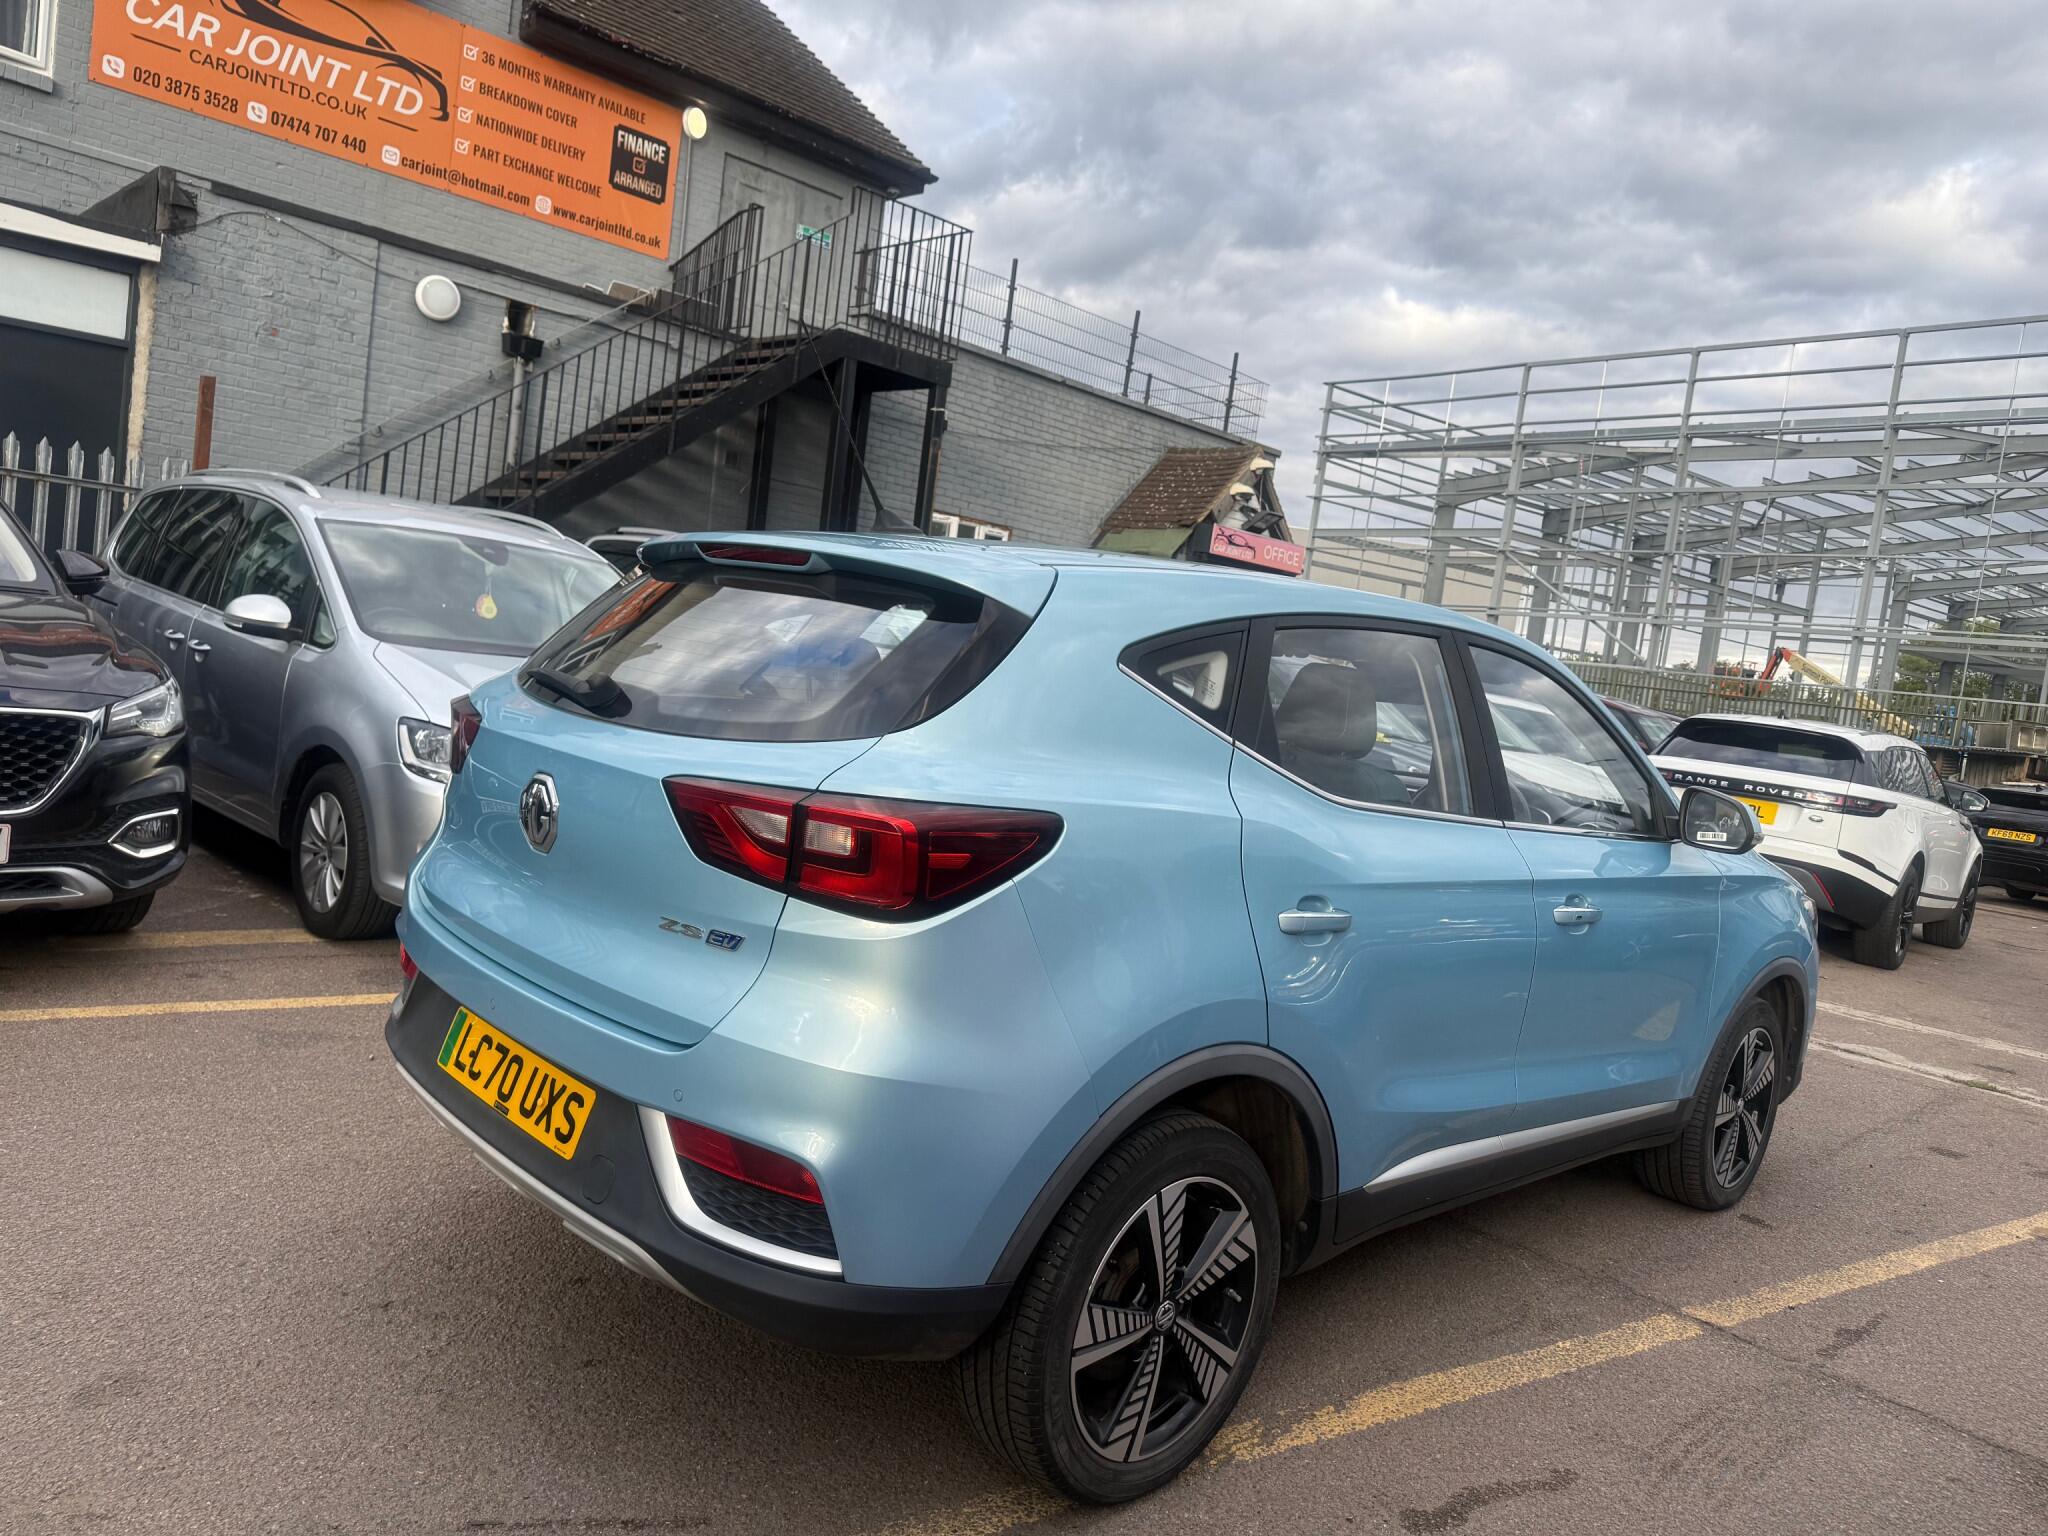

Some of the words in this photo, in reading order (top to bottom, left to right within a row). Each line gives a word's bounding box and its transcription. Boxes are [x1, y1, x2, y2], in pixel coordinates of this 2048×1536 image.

[126, 0, 221, 48] CAR
[225, 28, 351, 89] JOINT
[352, 70, 424, 115] LTD
[133, 66, 160, 88] 020
[164, 76, 200, 101] 3875
[203, 89, 239, 114] 3528
[189, 49, 367, 120] CARJOINTLTD.CO.UK
[479, 81, 543, 116] BREAKDOWN
[545, 106, 578, 129] COVER
[481, 51, 496, 67] 36
[498, 57, 541, 84] MONTHS
[543, 70, 596, 105] WARRANTY
[597, 97, 646, 125] AVAILABLE
[270, 110, 310, 136] 07474
[314, 124, 338, 144] 707
[341, 134, 367, 154] 440
[475, 113, 539, 146] NATIONWIDE
[540, 134, 586, 162] DELIVERY
[617, 129, 666, 164] FINANCE
[401, 156, 531, 207] carjoint@hotmail.com
[473, 144, 500, 164] PART
[502, 152, 555, 183] EXCHANGE
[556, 170, 603, 198] WELCOME
[613, 169, 662, 200] ARRANGED
[553, 202, 661, 249] www.carjointltd.co.uk
[1263, 544, 1300, 567] OFFICE
[1674, 774, 1729, 788] RANGE
[1744, 784, 1804, 799] ROVER
[658, 916, 704, 939] ZS
[706, 931, 743, 950] EV
[454, 1023, 521, 1103] LC70
[518, 1064, 585, 1145] UXS
